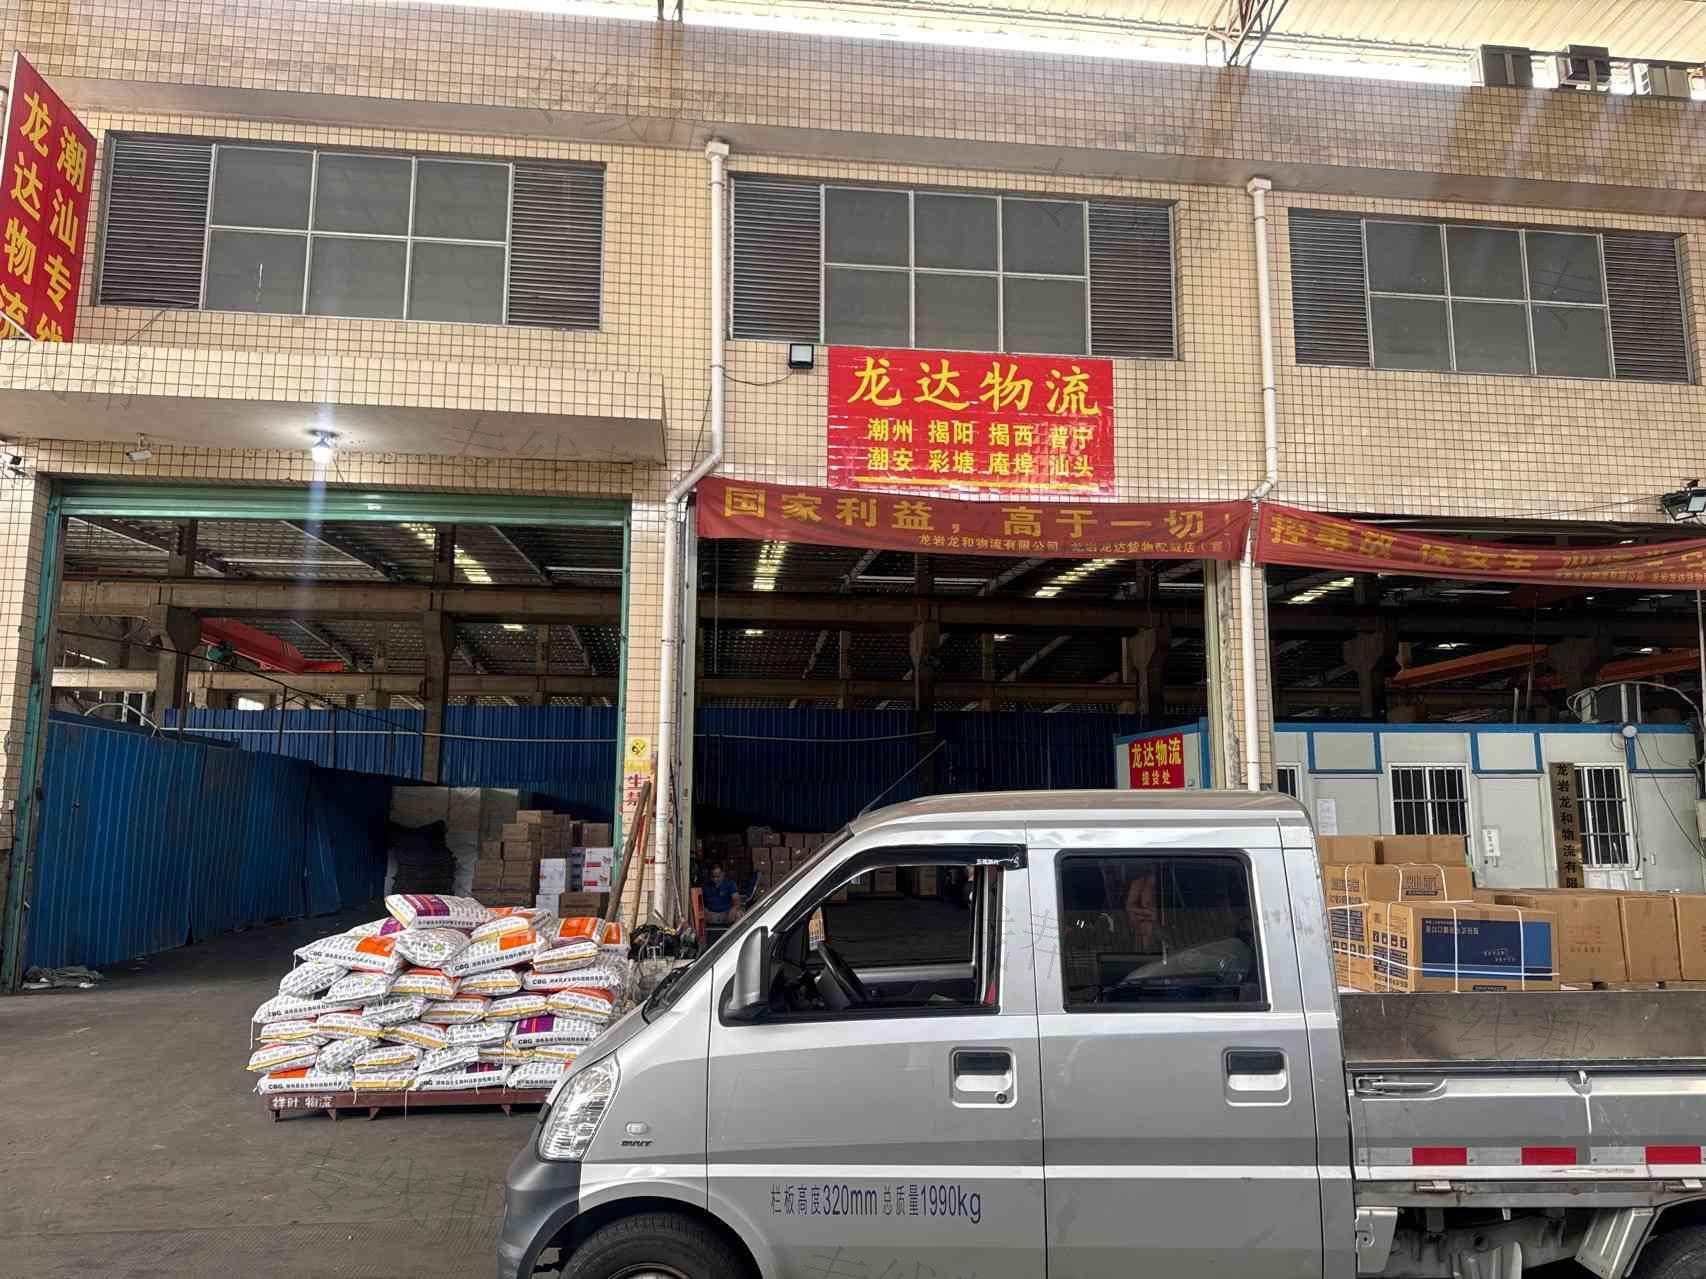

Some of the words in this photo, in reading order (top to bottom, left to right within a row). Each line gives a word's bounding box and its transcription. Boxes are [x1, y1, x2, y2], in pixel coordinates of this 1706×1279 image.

[848, 356, 1102, 416] 龙达物流
[867, 418, 913, 442] 潮州
[928, 420, 974, 445] 揭阳
[988, 423, 1034, 447] 揭西
[1049, 425, 1094, 450] 普宁
[867, 447, 914, 472] 潮安
[928, 450, 974, 474] 彩塘
[988, 452, 1034, 477] 庵埠
[1049, 454, 1094, 478] 汕头
[919, 534, 1059, 553] 龙岩龙和物流有限公司
[1131, 737, 1182, 768] 龙达物流
[1556, 763, 1579, 888] 龙岩龙和物流有限
[770, 1183, 879, 1216] 栏板高度320mm
[883, 1183, 983, 1224] 总质量1990kg
